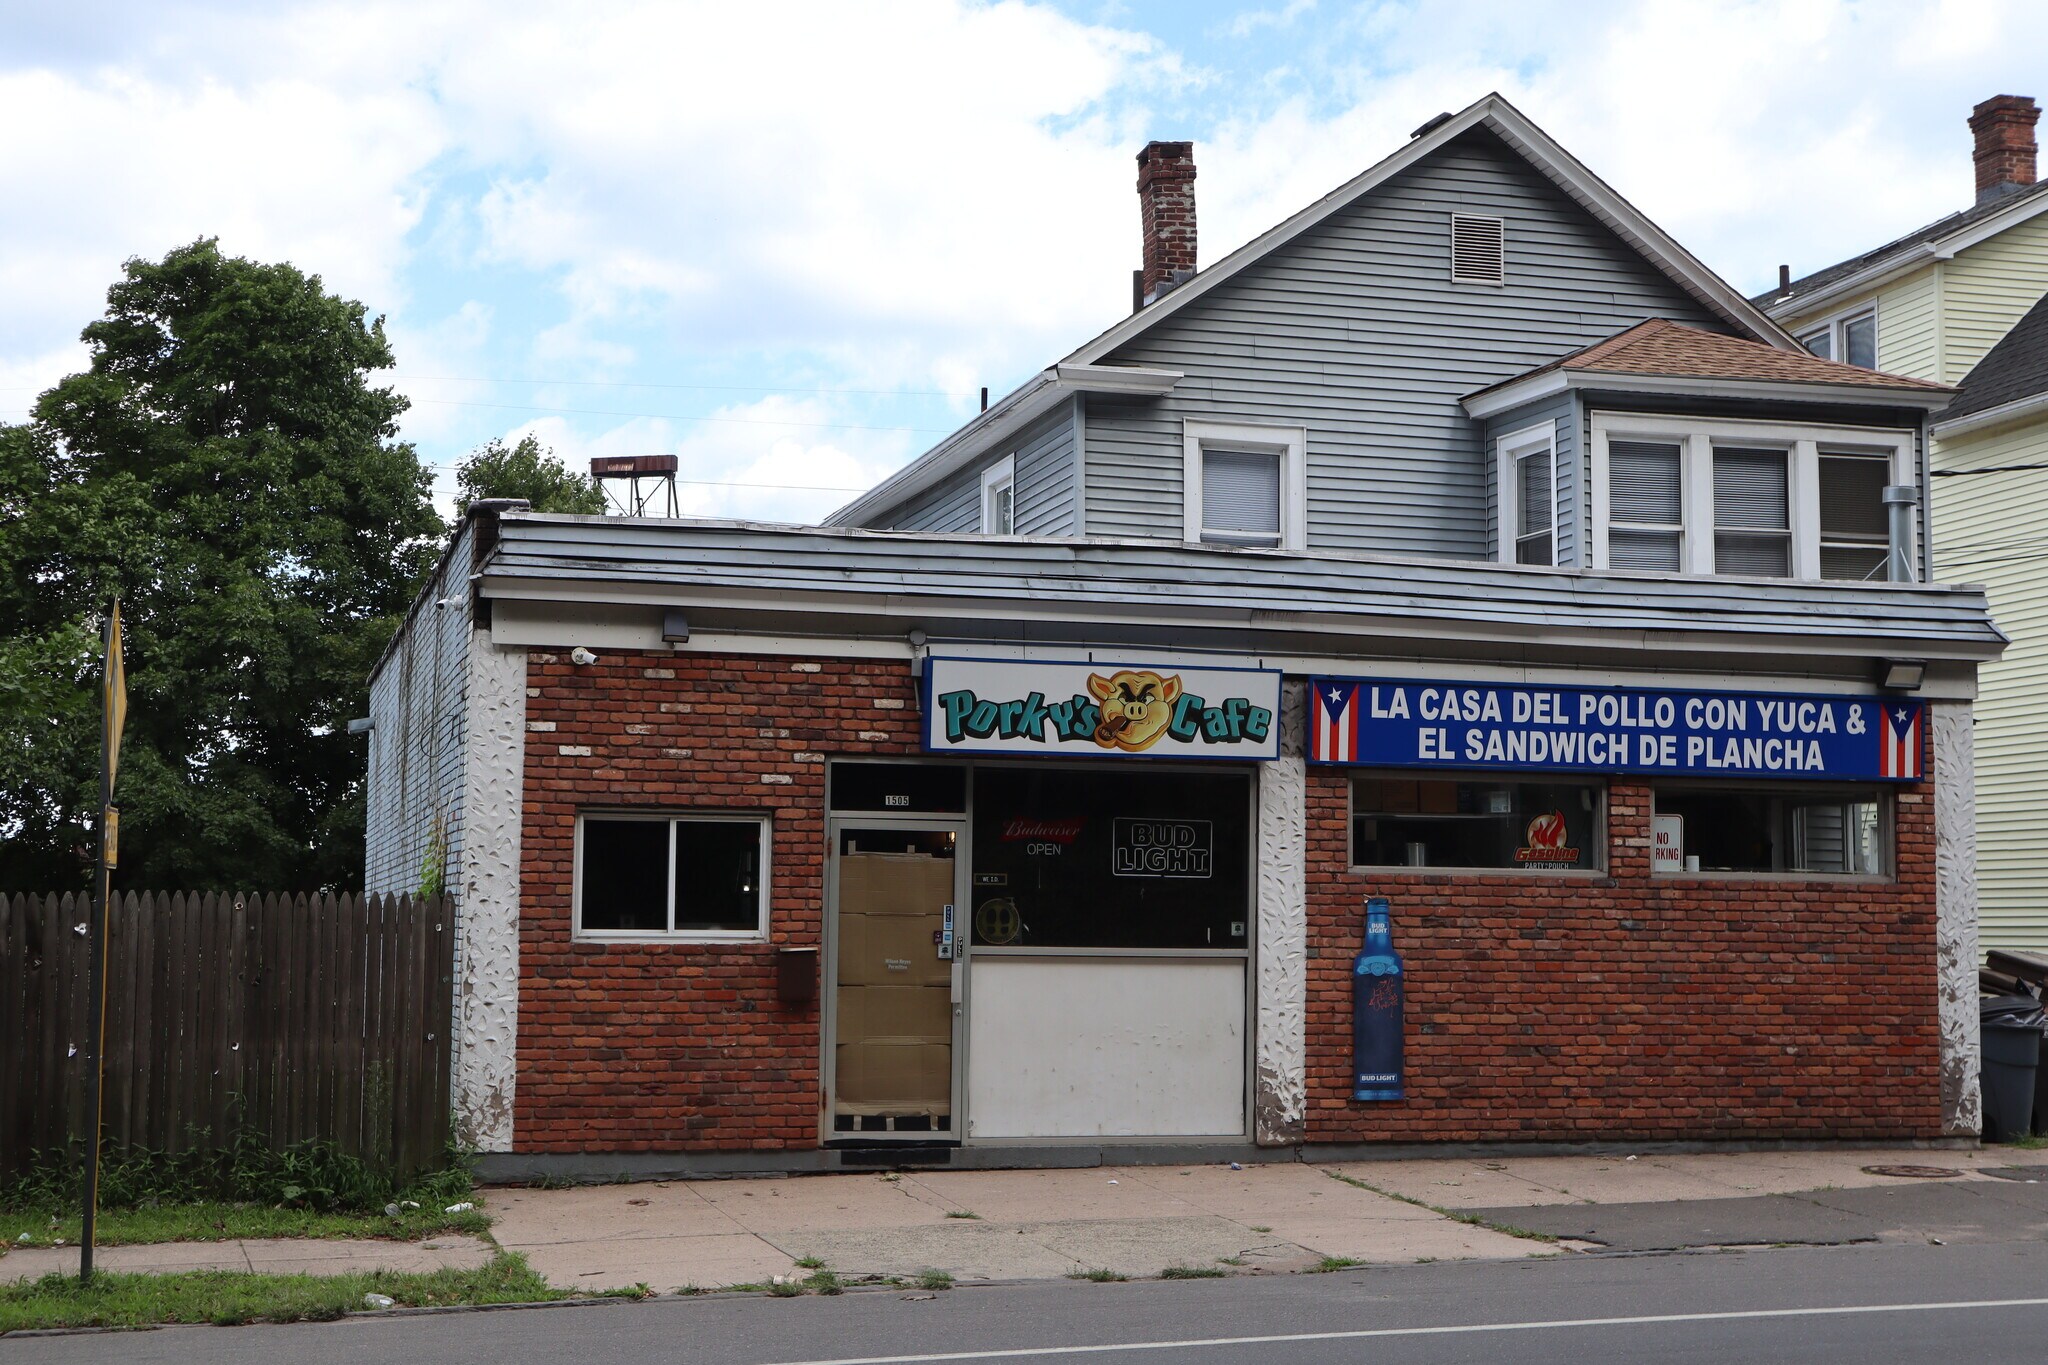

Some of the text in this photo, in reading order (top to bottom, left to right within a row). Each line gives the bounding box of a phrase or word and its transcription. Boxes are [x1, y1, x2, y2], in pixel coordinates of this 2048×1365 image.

[1166, 693, 1272, 744] Cafe
[1371, 686, 1866, 735] LA CASA DEL POLLO CON YUCA &
[1418, 727, 1825, 771] EL SANDWICH DE PLANCHA
[886, 796, 909, 805] 1505
[1003, 820, 1081, 837] Budweiser
[1131, 823, 1196, 848] BUD
[1656, 831, 1669, 845] NO
[1026, 843, 1062, 856] OPEN
[1514, 847, 1580, 862] Gasoline
[1655, 847, 1679, 861] RKING
[1117, 847, 1209, 872] LIGHT
[1524, 862, 1545, 870] PARTY
[1548, 862, 1569, 870] POUCH
